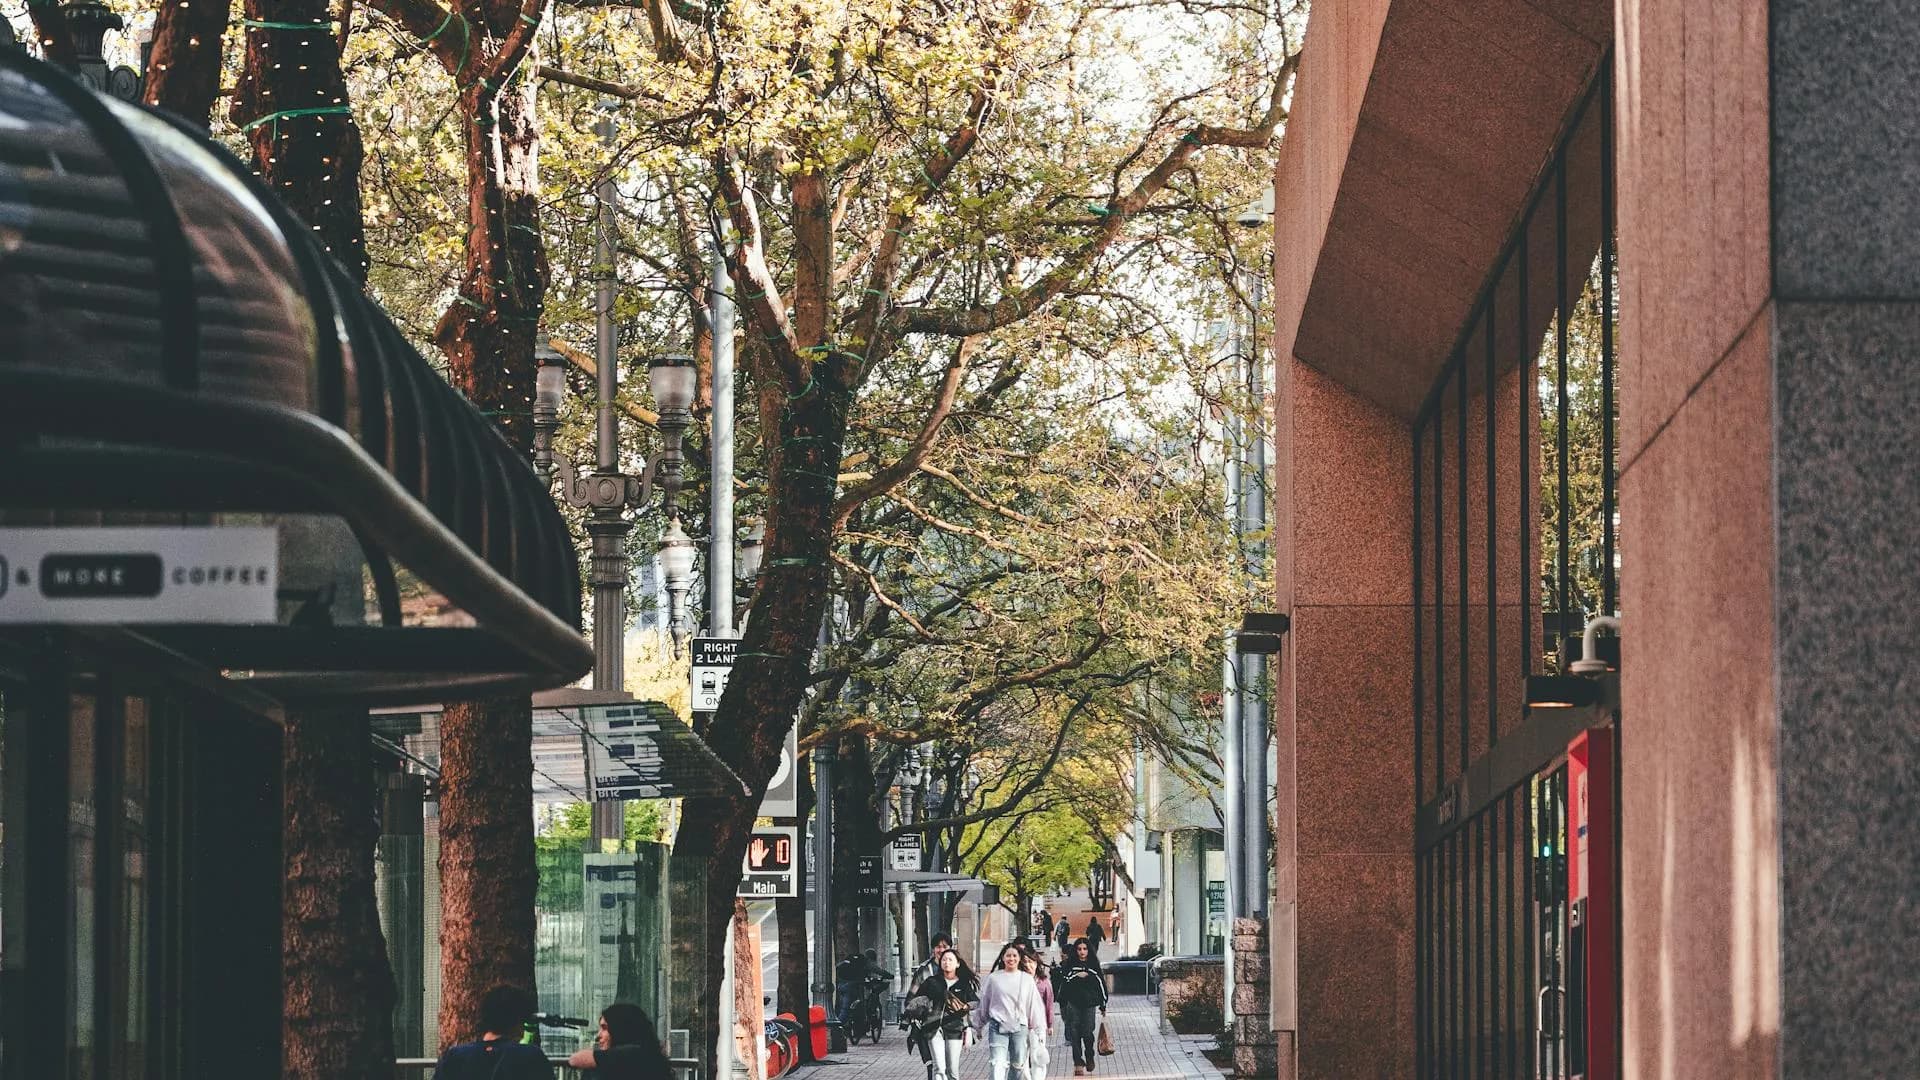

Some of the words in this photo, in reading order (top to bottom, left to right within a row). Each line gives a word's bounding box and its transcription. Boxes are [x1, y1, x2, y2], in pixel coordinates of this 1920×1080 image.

[172, 565, 268, 586] COFFEE
[703, 642, 738, 653] RIGHT
[695, 653, 704, 664] 2
[707, 653, 738, 664] LANE
[705, 697, 721, 706] ON
[776, 839, 790, 864] 10
[781, 874, 790, 882] ST
[753, 880, 777, 894] Main
